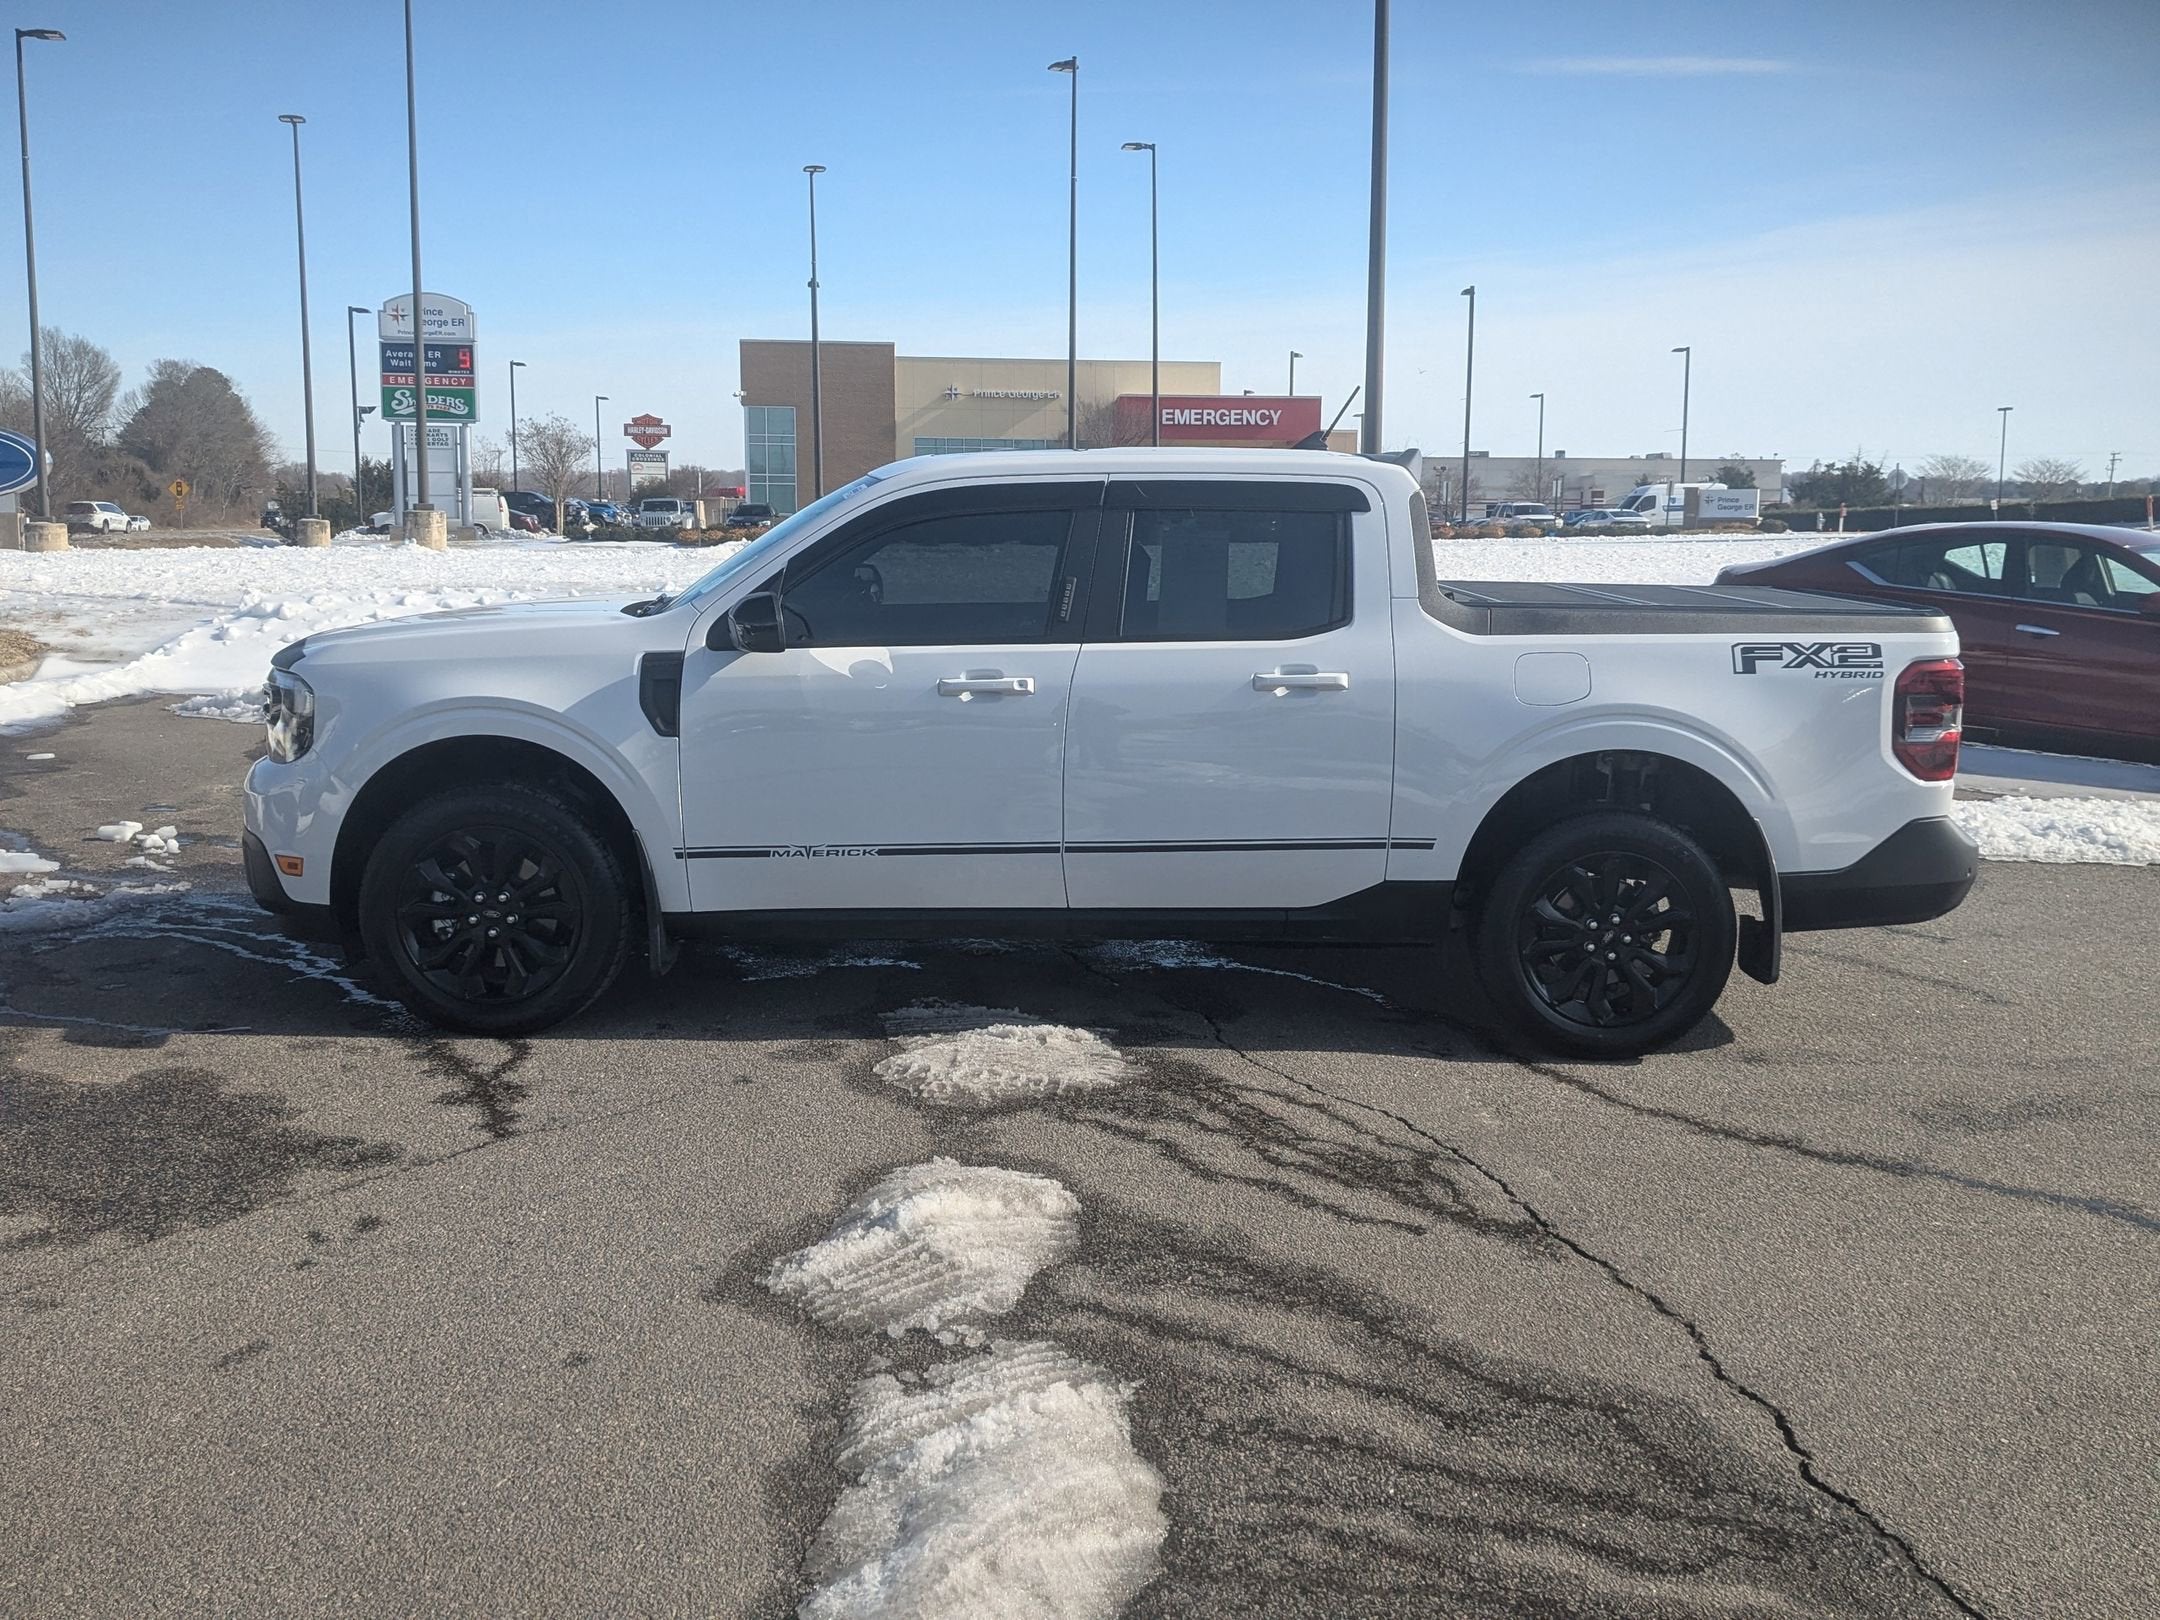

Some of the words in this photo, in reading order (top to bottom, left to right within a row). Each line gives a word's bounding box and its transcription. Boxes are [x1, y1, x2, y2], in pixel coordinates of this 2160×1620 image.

[423, 306, 444, 316] ince
[422, 318, 448, 328] eorge
[452, 318, 465, 326] ER
[386, 350, 424, 358] Avera
[428, 350, 441, 358] ER
[459, 349, 471, 368] 9
[390, 359, 412, 367] Wait
[389, 376, 467, 386] EMEGENCY
[974, 390, 1006, 398] Prince
[1008, 390, 1044, 400] George
[1162, 408, 1282, 426] EMERGENCY
[1731, 642, 1884, 674] FX2
[772, 846, 878, 860] MAVERICK
